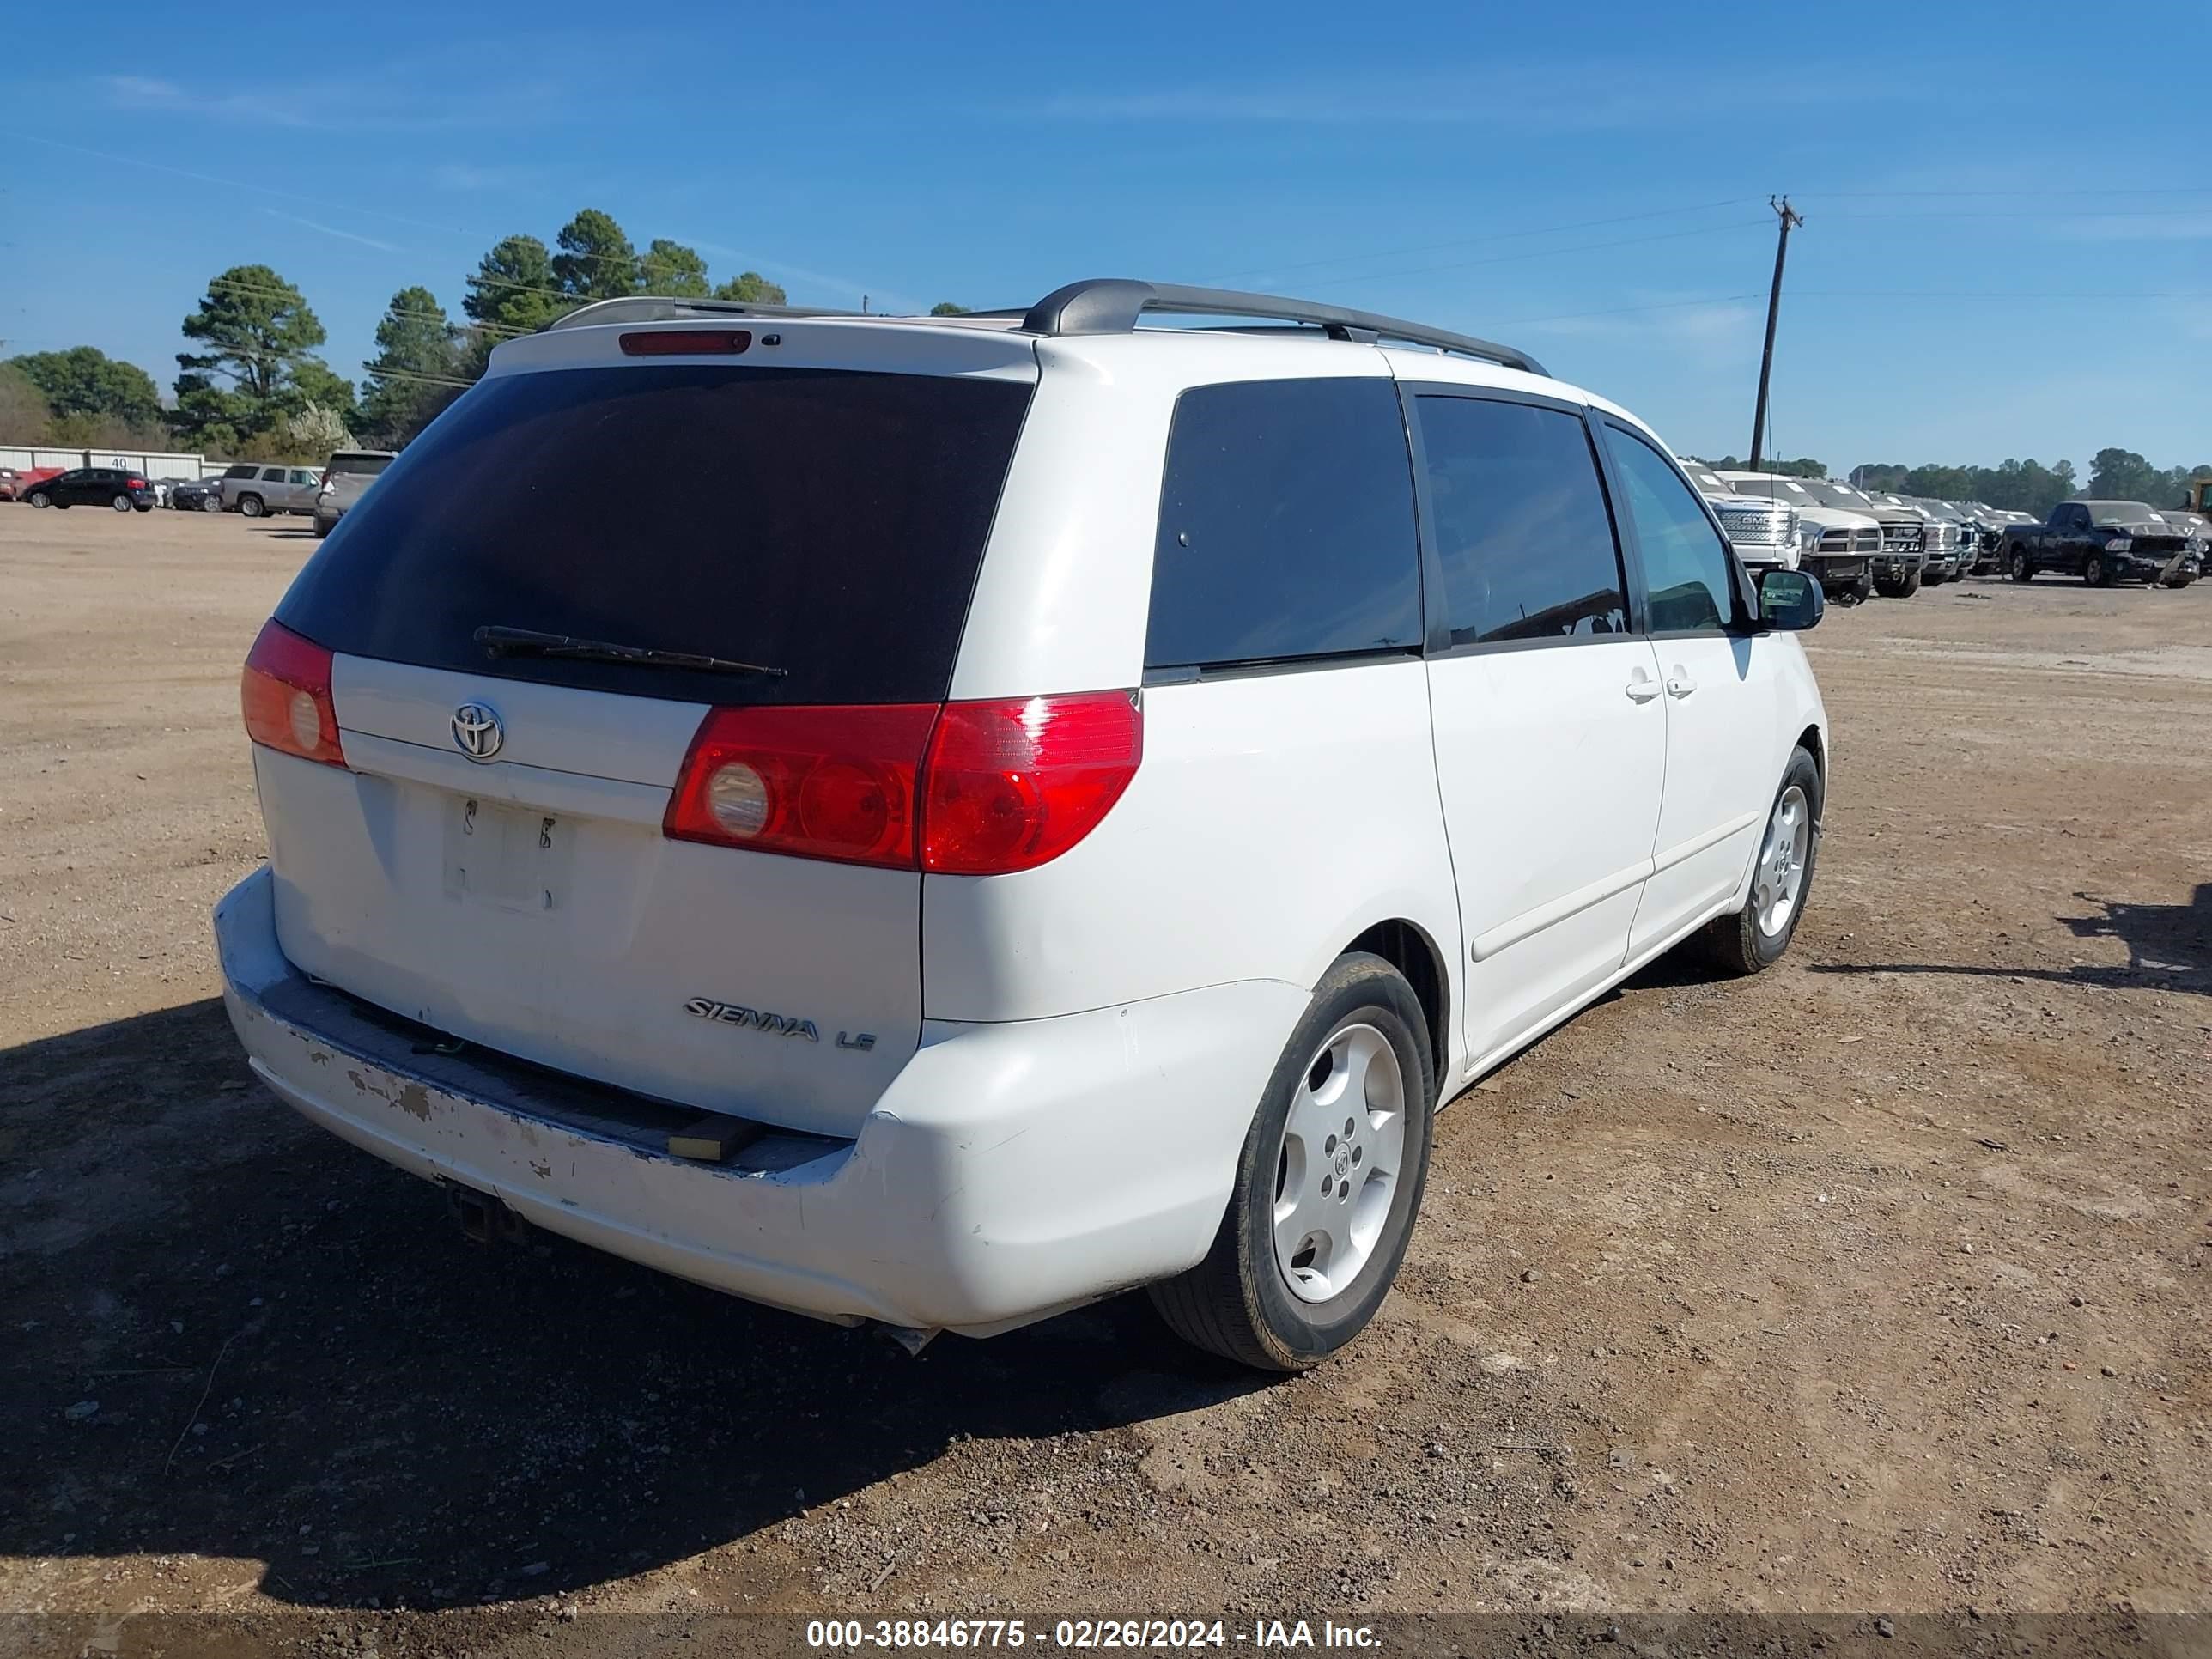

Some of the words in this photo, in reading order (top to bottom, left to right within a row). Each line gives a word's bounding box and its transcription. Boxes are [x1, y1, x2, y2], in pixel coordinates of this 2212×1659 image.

[112, 458, 127, 468] 40
[1741, 516, 1775, 526] GMC
[683, 996, 818, 1042] SIENNA
[836, 1030, 877, 1051] LE
